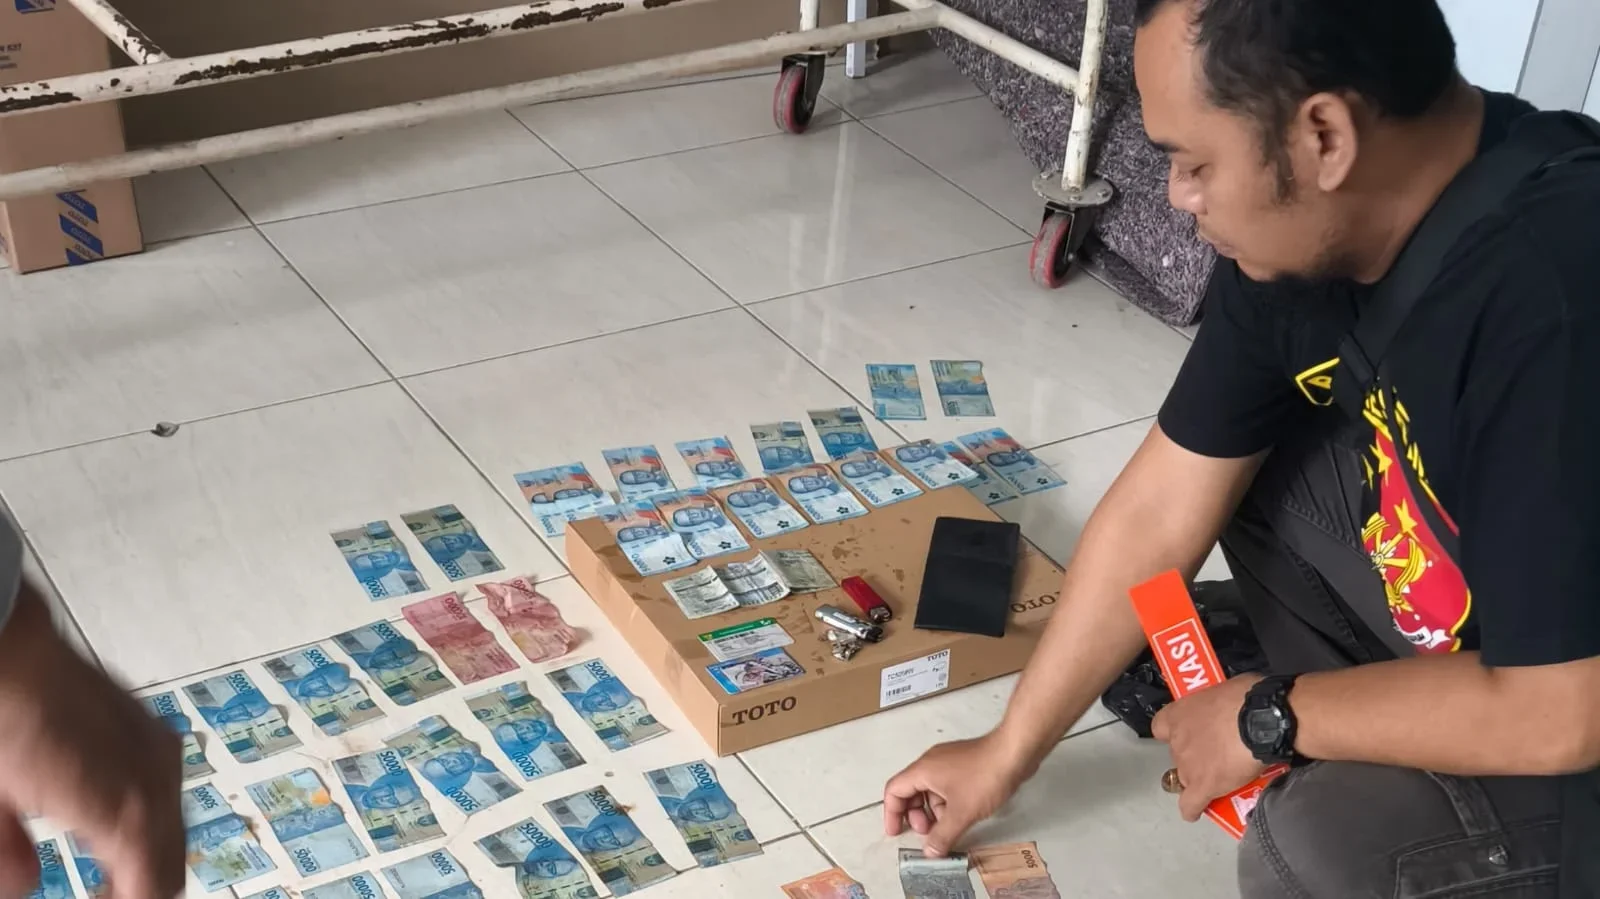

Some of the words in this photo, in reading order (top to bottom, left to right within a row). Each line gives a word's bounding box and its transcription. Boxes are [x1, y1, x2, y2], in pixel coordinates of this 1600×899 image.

[1011, 592, 1060, 613] OTO
[1166, 631, 1210, 692] KASI
[732, 696, 797, 726] TOTO
[379, 751, 403, 776] 50000
[512, 751, 539, 777] 50000
[689, 763, 716, 790] 50000
[195, 787, 218, 808] 50000
[446, 786, 478, 811] 50000
[589, 791, 618, 816] 50000
[523, 822, 552, 849] 50000
[294, 848, 317, 873] 50000
[431, 852, 455, 875] 50000
[1021, 849, 1038, 869] 5000
[352, 875, 375, 899] 50000
